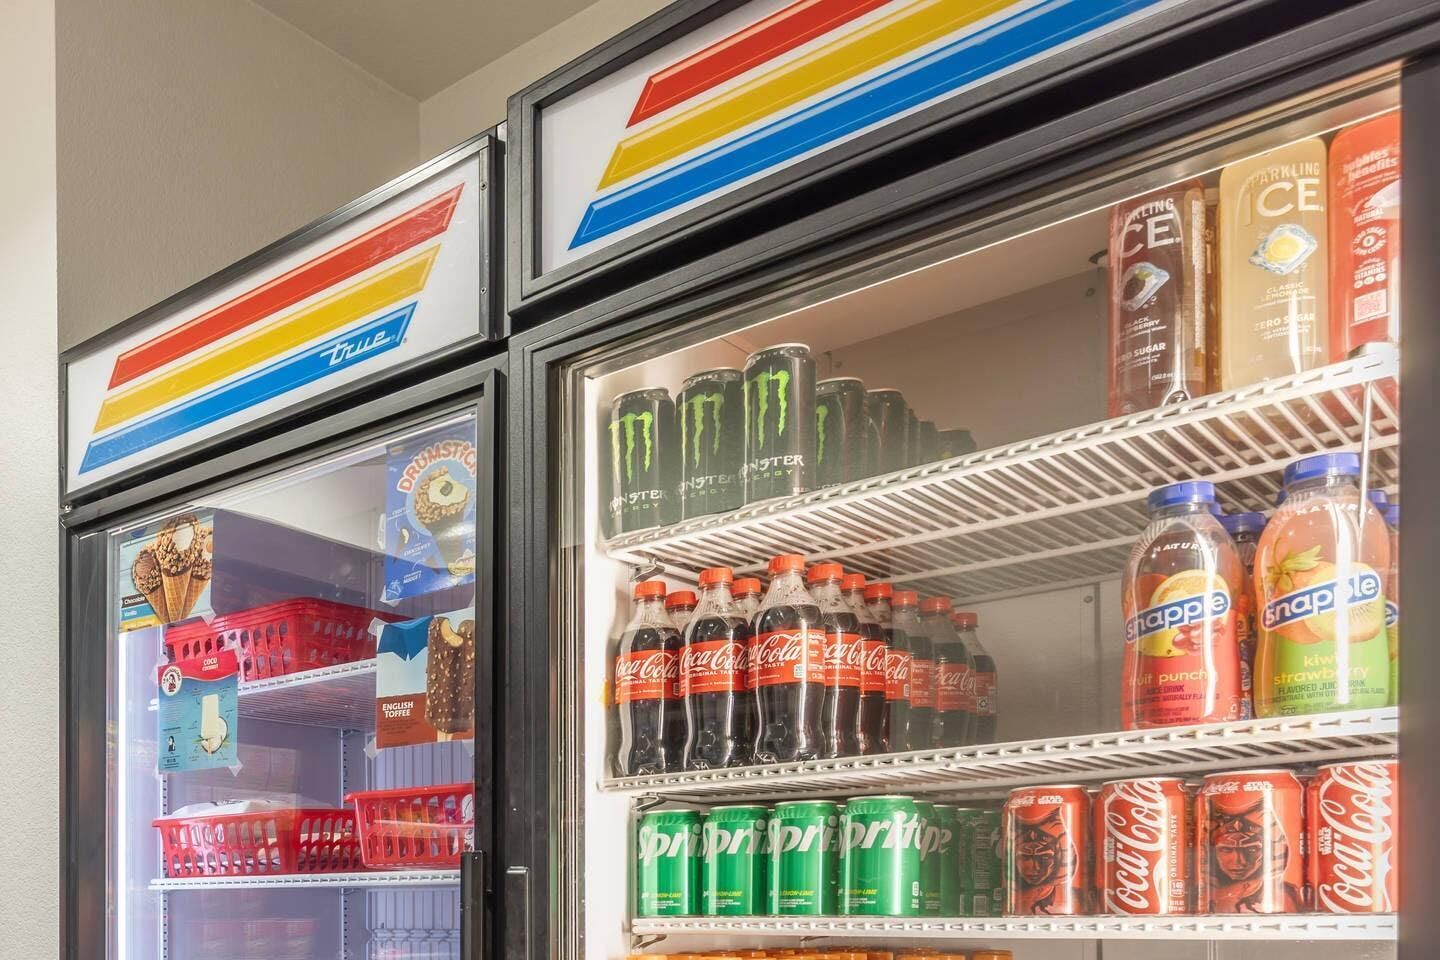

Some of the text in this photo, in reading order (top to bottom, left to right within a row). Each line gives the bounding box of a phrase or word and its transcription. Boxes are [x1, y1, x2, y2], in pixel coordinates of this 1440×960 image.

[1283, 314, 1315, 325] SGAR
[320, 331, 390, 366] true
[1134, 342, 1166, 358] SUGAR
[681, 643, 748, 675] Coca-Cola
[1304, 654, 1334, 668] kiw
[1159, 669, 1207, 685] punch
[1279, 682, 1337, 695] FLAVORED JUIC
[382, 702, 413, 711] ENGLISH
[384, 709, 410, 718] TOFFEE
[639, 823, 703, 865] Spri
[704, 820, 768, 863] Spri
[769, 816, 838, 861] Spri
[1320, 764, 1392, 912] Coca-Cola
